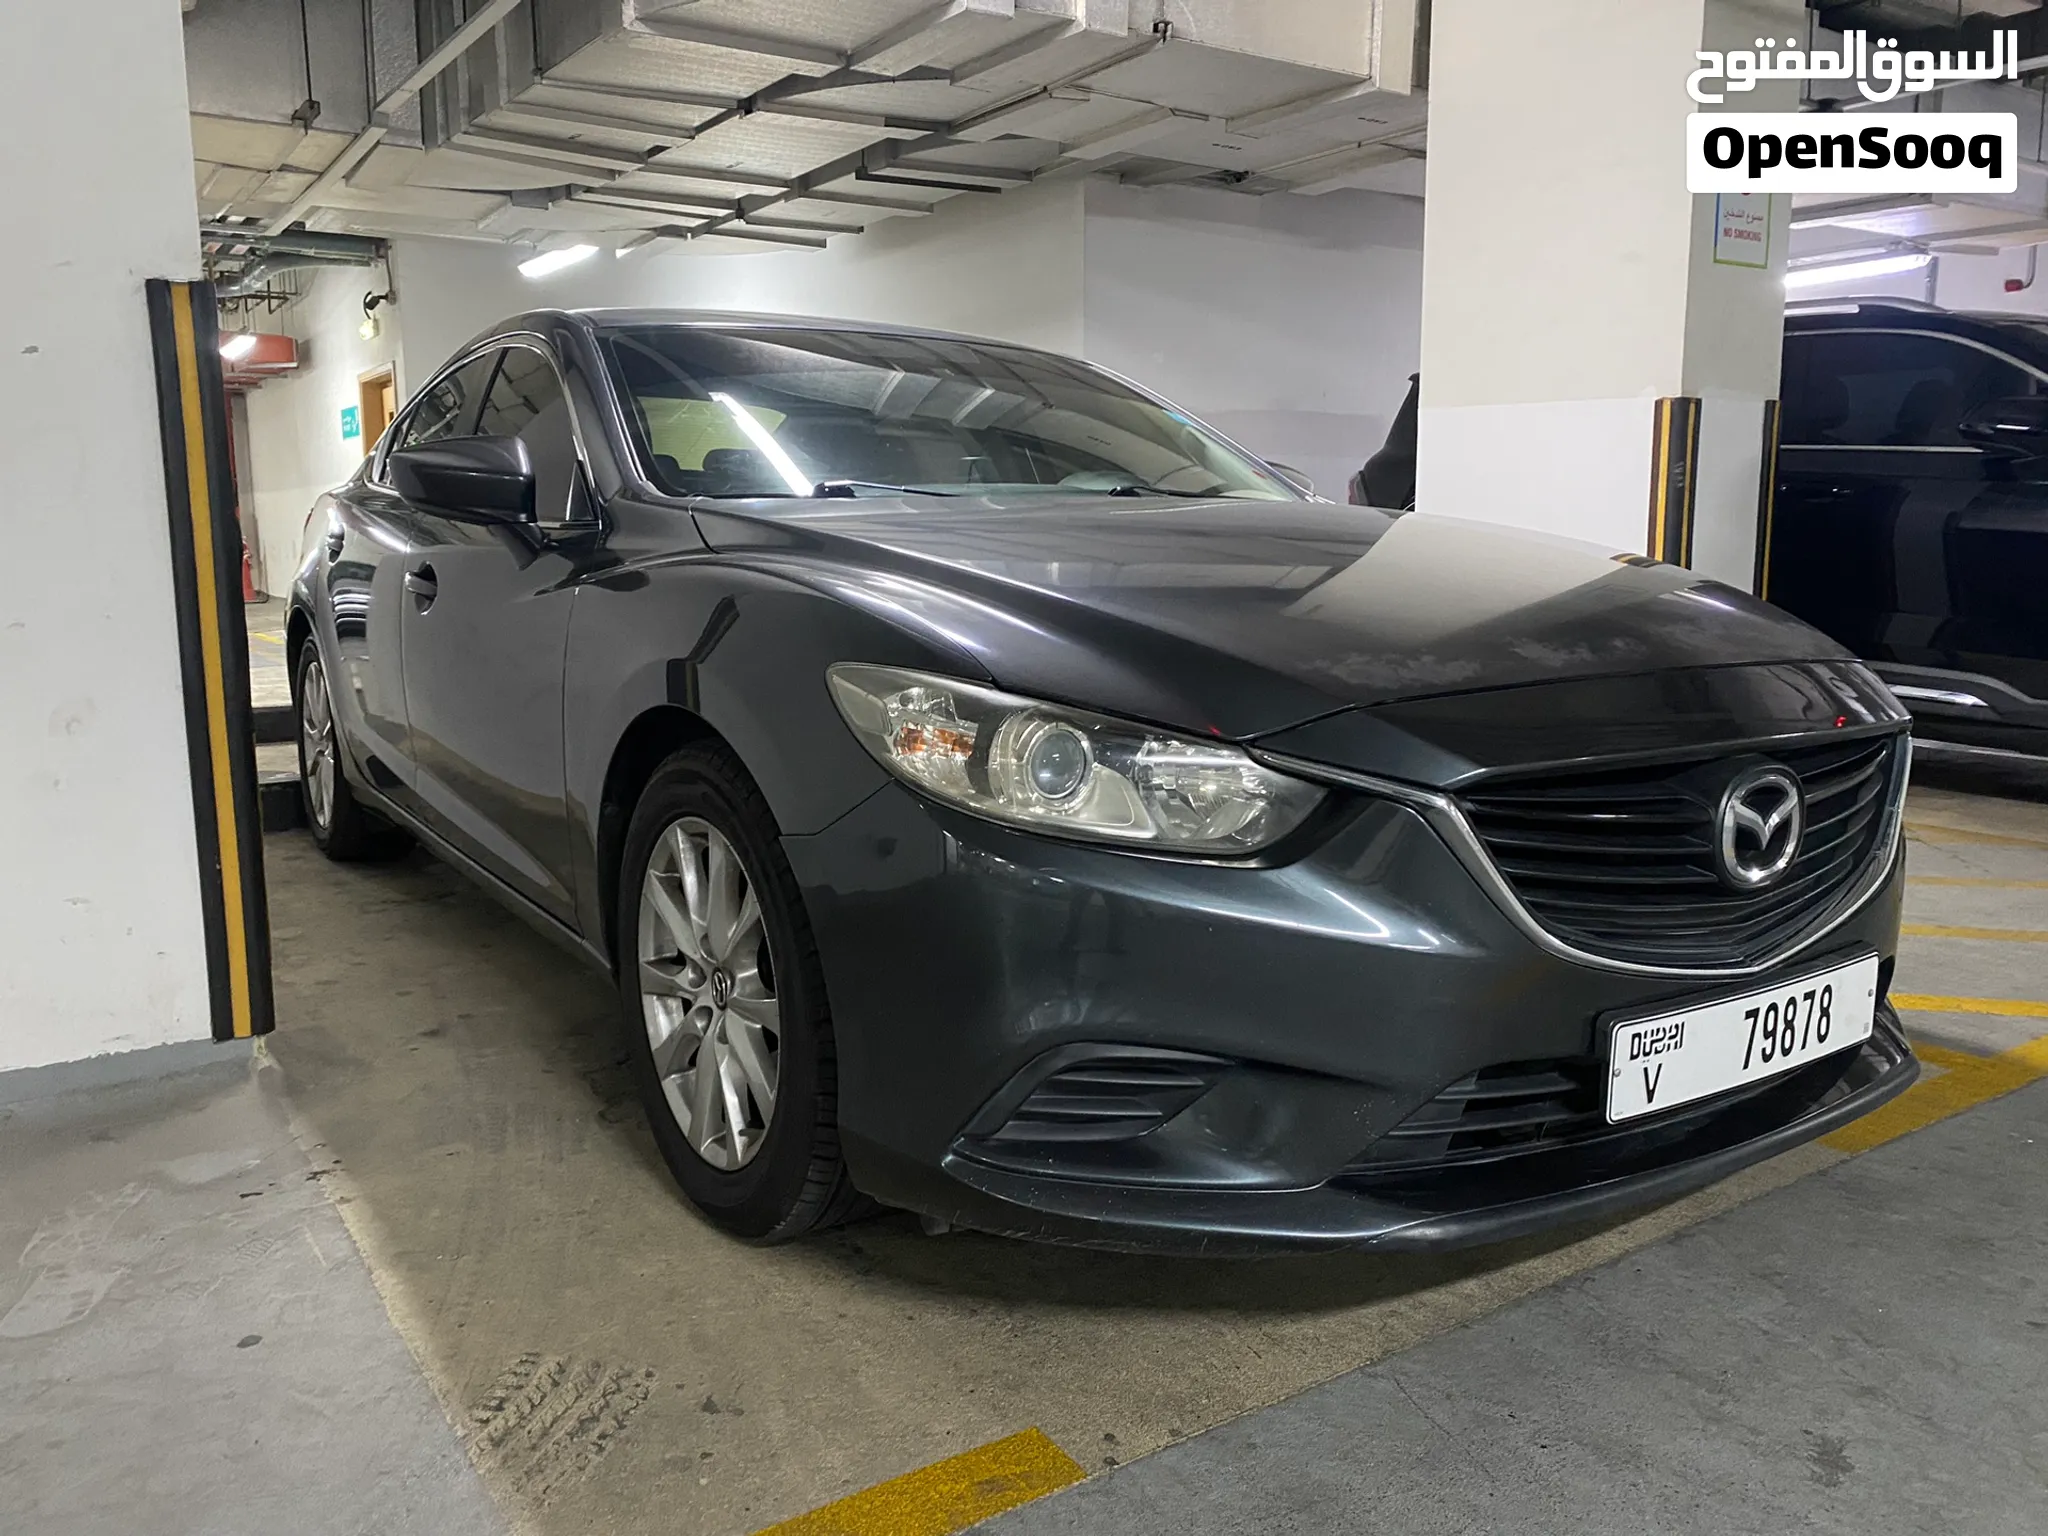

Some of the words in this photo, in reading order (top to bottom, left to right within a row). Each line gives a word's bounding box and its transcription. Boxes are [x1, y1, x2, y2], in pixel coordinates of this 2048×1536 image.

[1723, 227, 1733, 238] NO
[1734, 228, 1762, 242] SMOKING
[1742, 984, 1833, 1070] 79878
[1643, 1063, 1663, 1104] V
